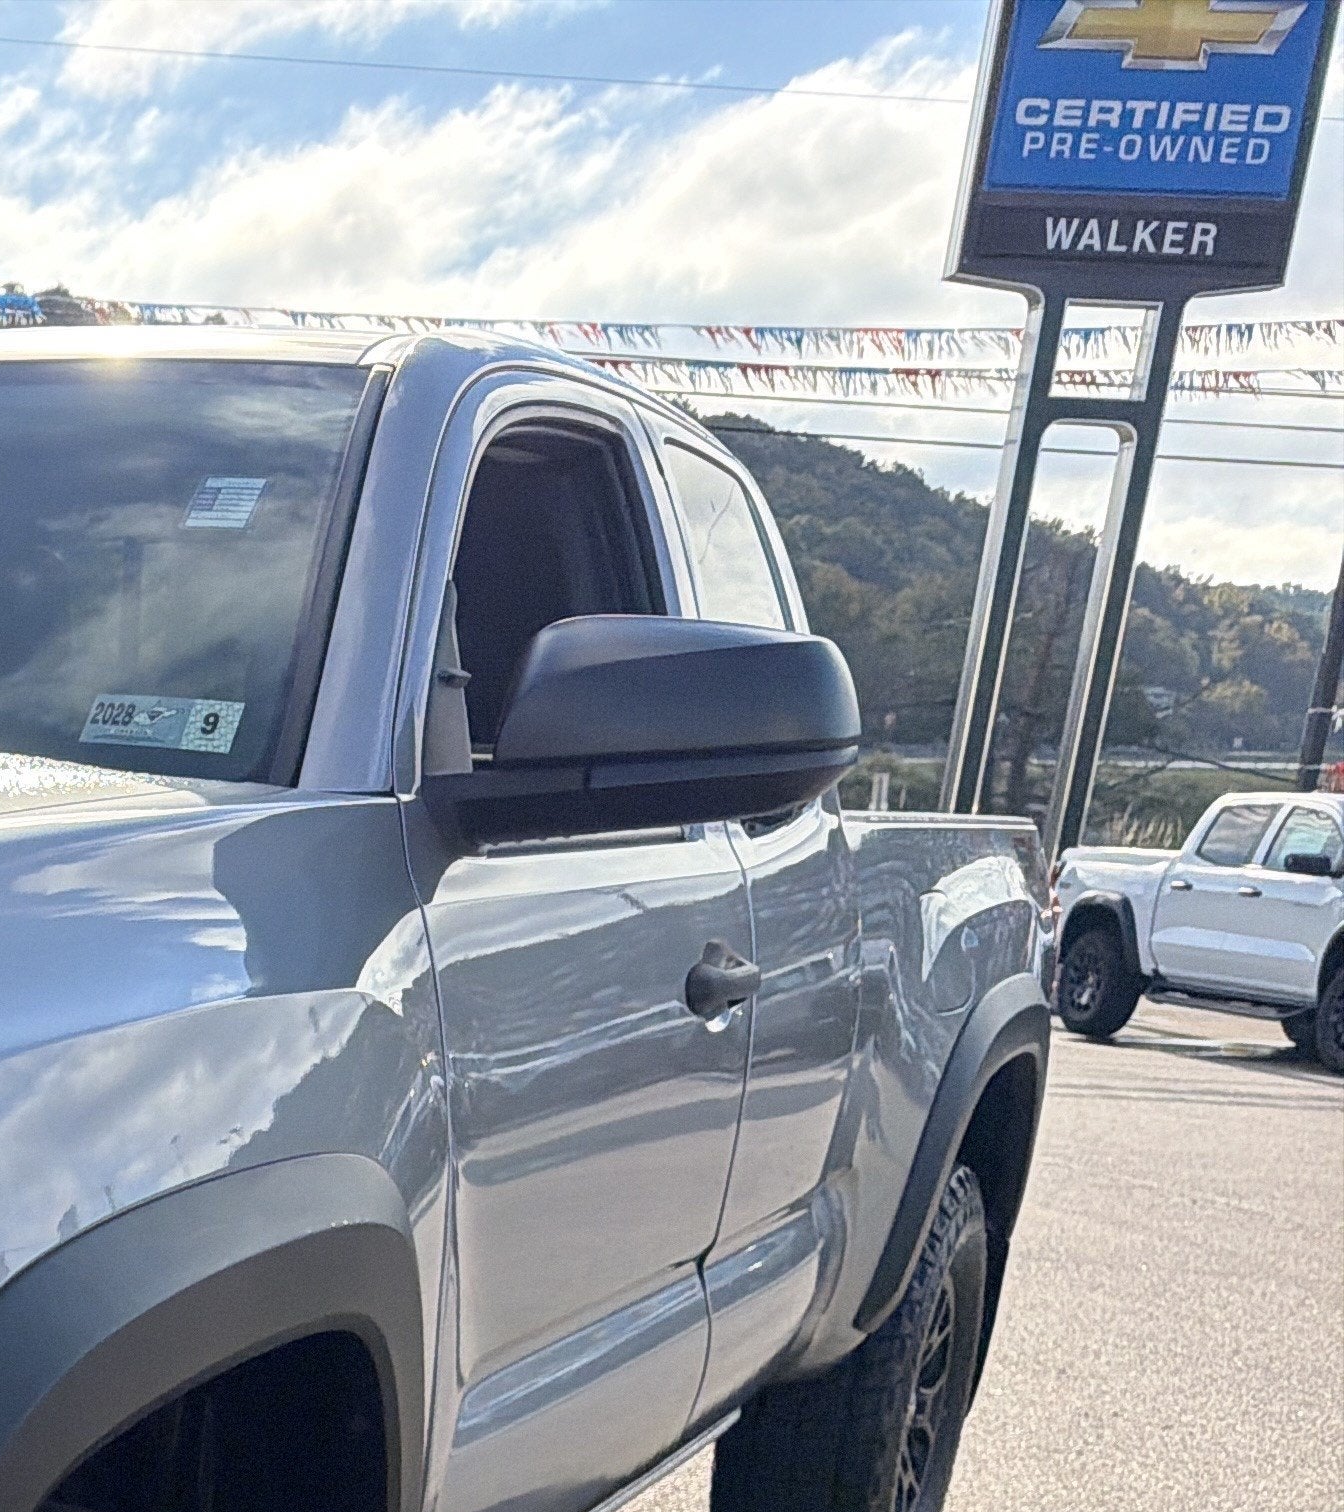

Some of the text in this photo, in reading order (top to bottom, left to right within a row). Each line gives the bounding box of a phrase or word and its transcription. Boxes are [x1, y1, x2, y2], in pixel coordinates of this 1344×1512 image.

[1015, 97, 1292, 134] CERTIFIED
[1021, 131, 1271, 166] PRE-OWNED
[1045, 216, 1218, 256] WALKER
[90, 702, 136, 726] 2028
[200, 712, 220, 735] 9
